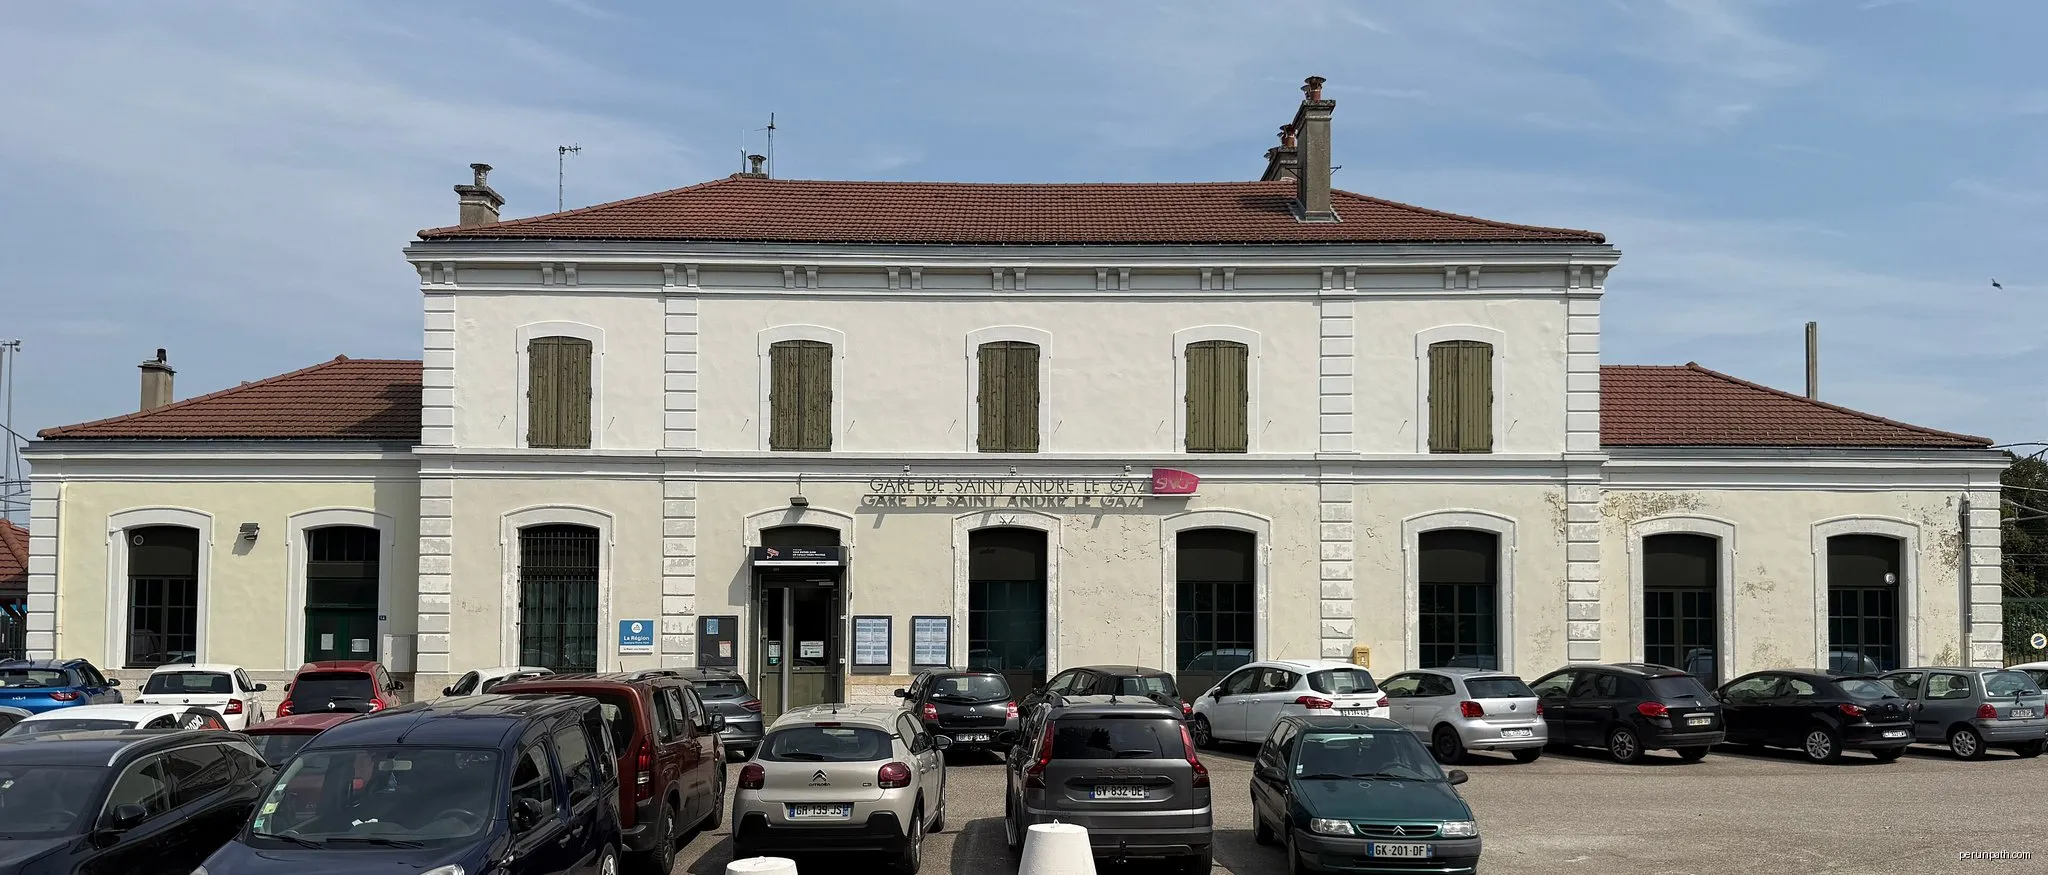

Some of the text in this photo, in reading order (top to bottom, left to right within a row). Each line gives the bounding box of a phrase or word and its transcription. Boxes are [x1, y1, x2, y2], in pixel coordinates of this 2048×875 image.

[869, 478, 915, 493] GARE
[925, 478, 945, 493] DE
[955, 478, 1006, 493] SAINT
[1015, 478, 1074, 493] ANDRE
[1084, 478, 1100, 493] LE
[1096, 785, 1143, 797] GV-832-DE
[1375, 844, 1425, 856] GK-201-DF
